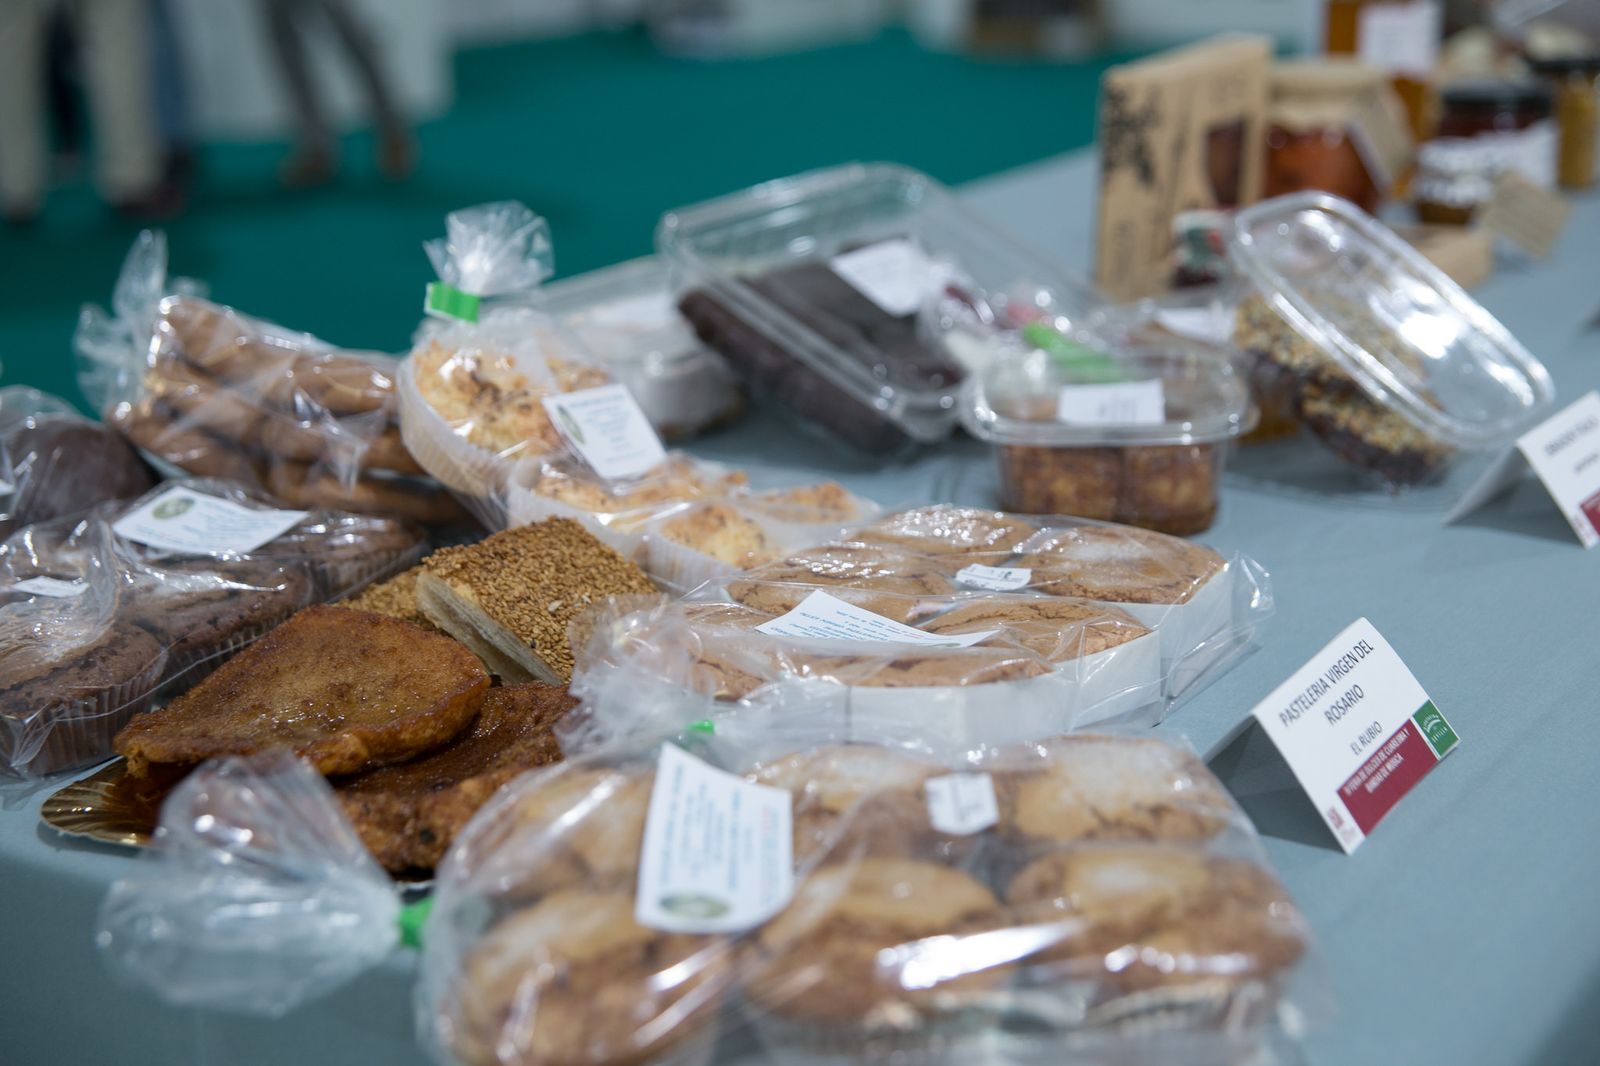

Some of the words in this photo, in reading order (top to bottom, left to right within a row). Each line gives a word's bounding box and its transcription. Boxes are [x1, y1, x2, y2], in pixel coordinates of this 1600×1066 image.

[1279, 678, 1331, 727] PASTELERIA
[1325, 651, 1359, 684] VIRGEN
[1353, 639, 1374, 659] DEL
[1324, 684, 1364, 725] ROSARIO
[1350, 741, 1362, 755] EL
[1358, 720, 1382, 747] RUBIO
